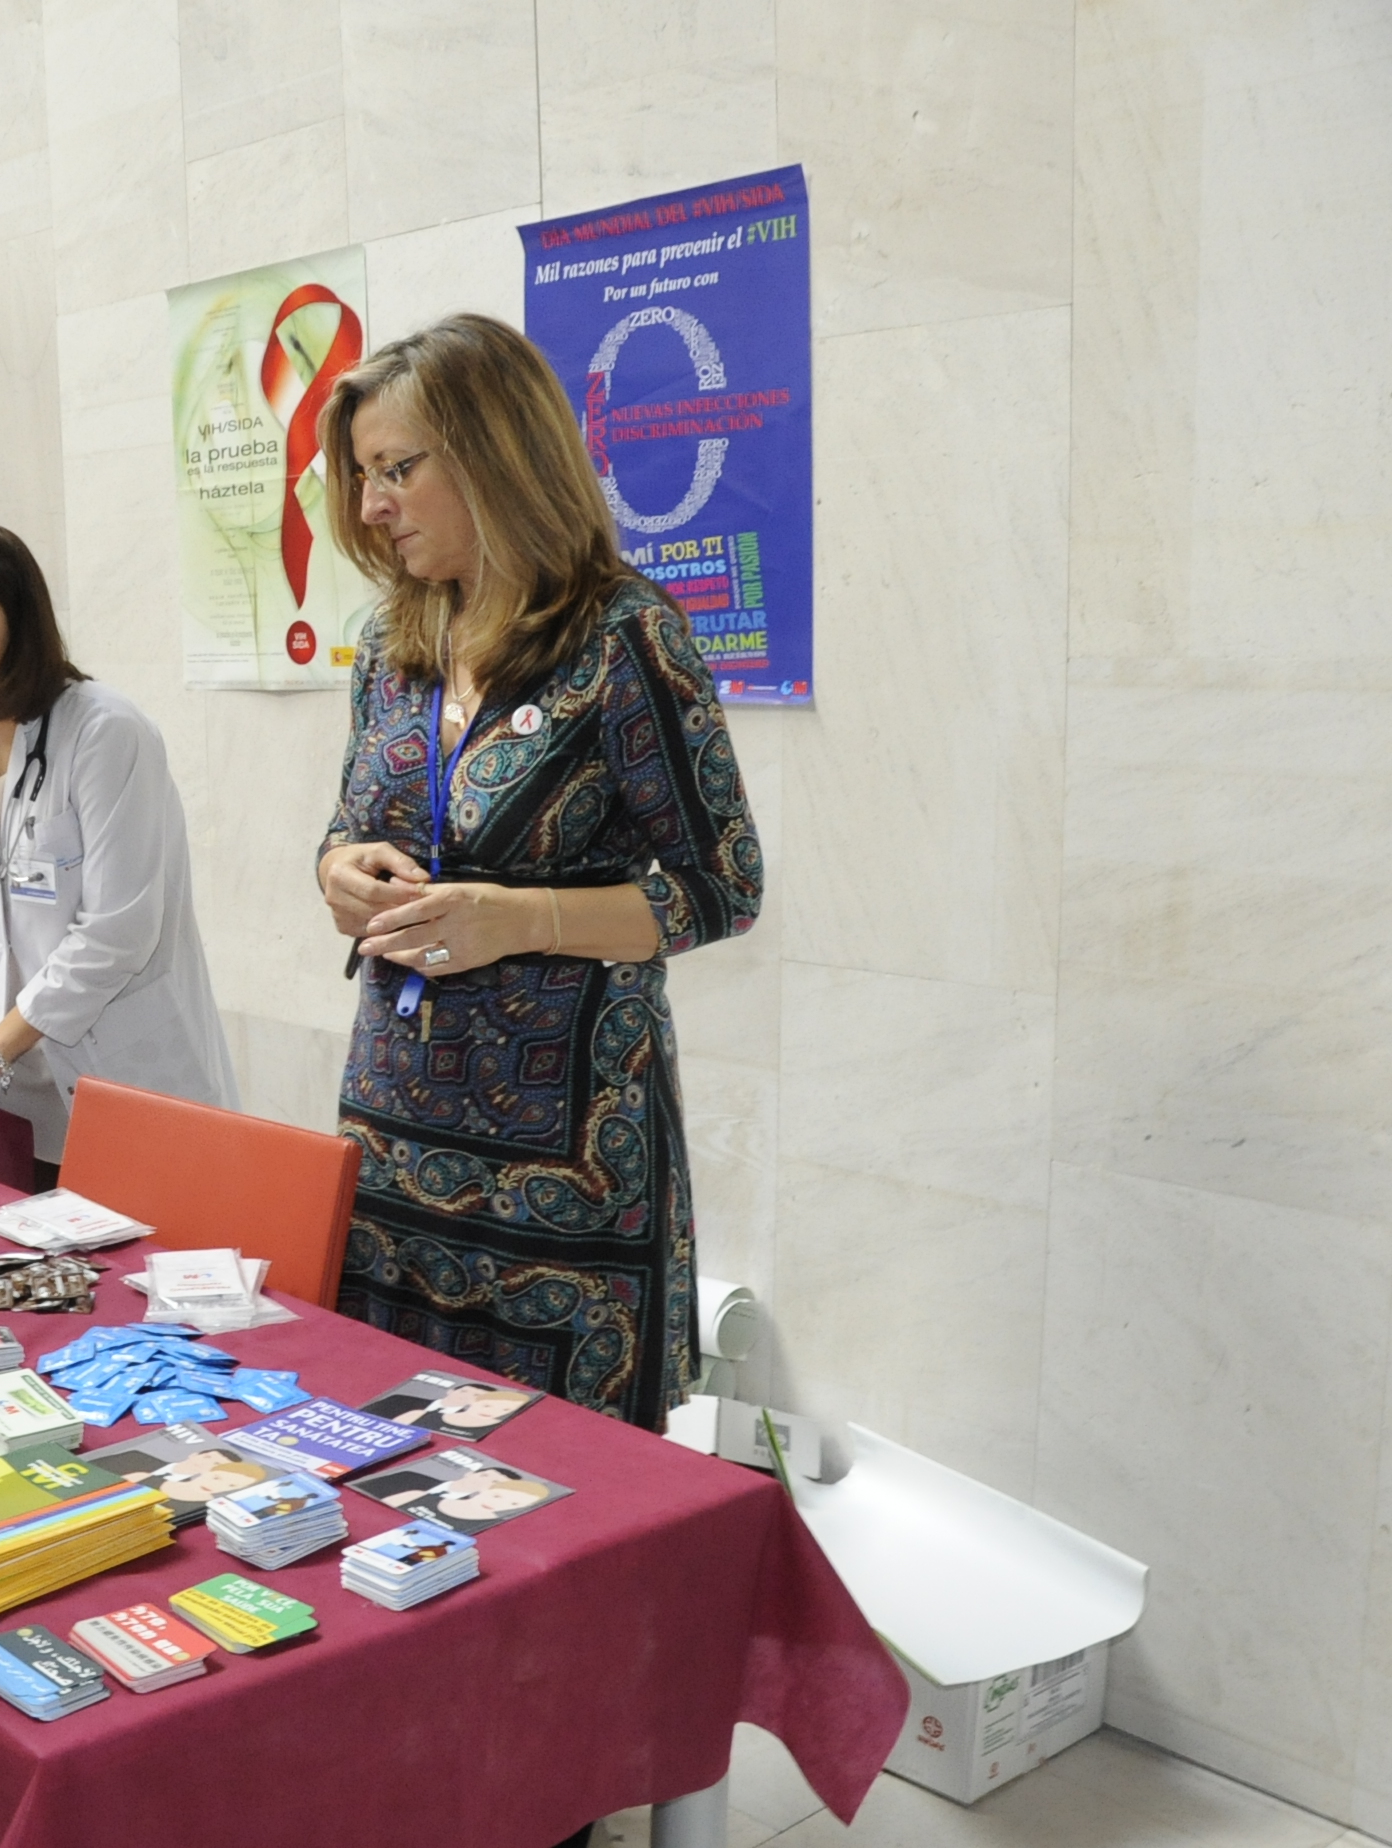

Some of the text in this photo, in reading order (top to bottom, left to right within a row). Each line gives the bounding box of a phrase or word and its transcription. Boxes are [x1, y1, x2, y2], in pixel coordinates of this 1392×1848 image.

[573, 211, 653, 242] MUNDIAL
[655, 202, 688, 227] DEL
[534, 214, 797, 286] Mil razones para prevenir el #VIH
[603, 271, 720, 303] Por un futuro con
[629, 306, 675, 328] ZERO
[611, 386, 791, 423] NUEVAS INFECCIONES
[198, 415, 264, 438] VIH/SIDA
[185, 438, 279, 465] la prueba
[186, 455, 279, 477] es la respuesta
[198, 480, 265, 501] háztela
[660, 539, 701, 563] POR
[702, 535, 724, 556] TI
[638, 558, 727, 581] OSOTROS
[740, 581, 765, 609] POR
[293, 632, 308, 641] VIH
[691, 630, 769, 655] DARME
[309, 1400, 374, 1427] PENTRU
[165, 1423, 206, 1445] HIV
[286, 1408, 408, 1449] PENTRU
[438, 1450, 484, 1472] SIDA
[220, 1583, 286, 1614] PELA SUA
[232, 1579, 262, 1593] POR
